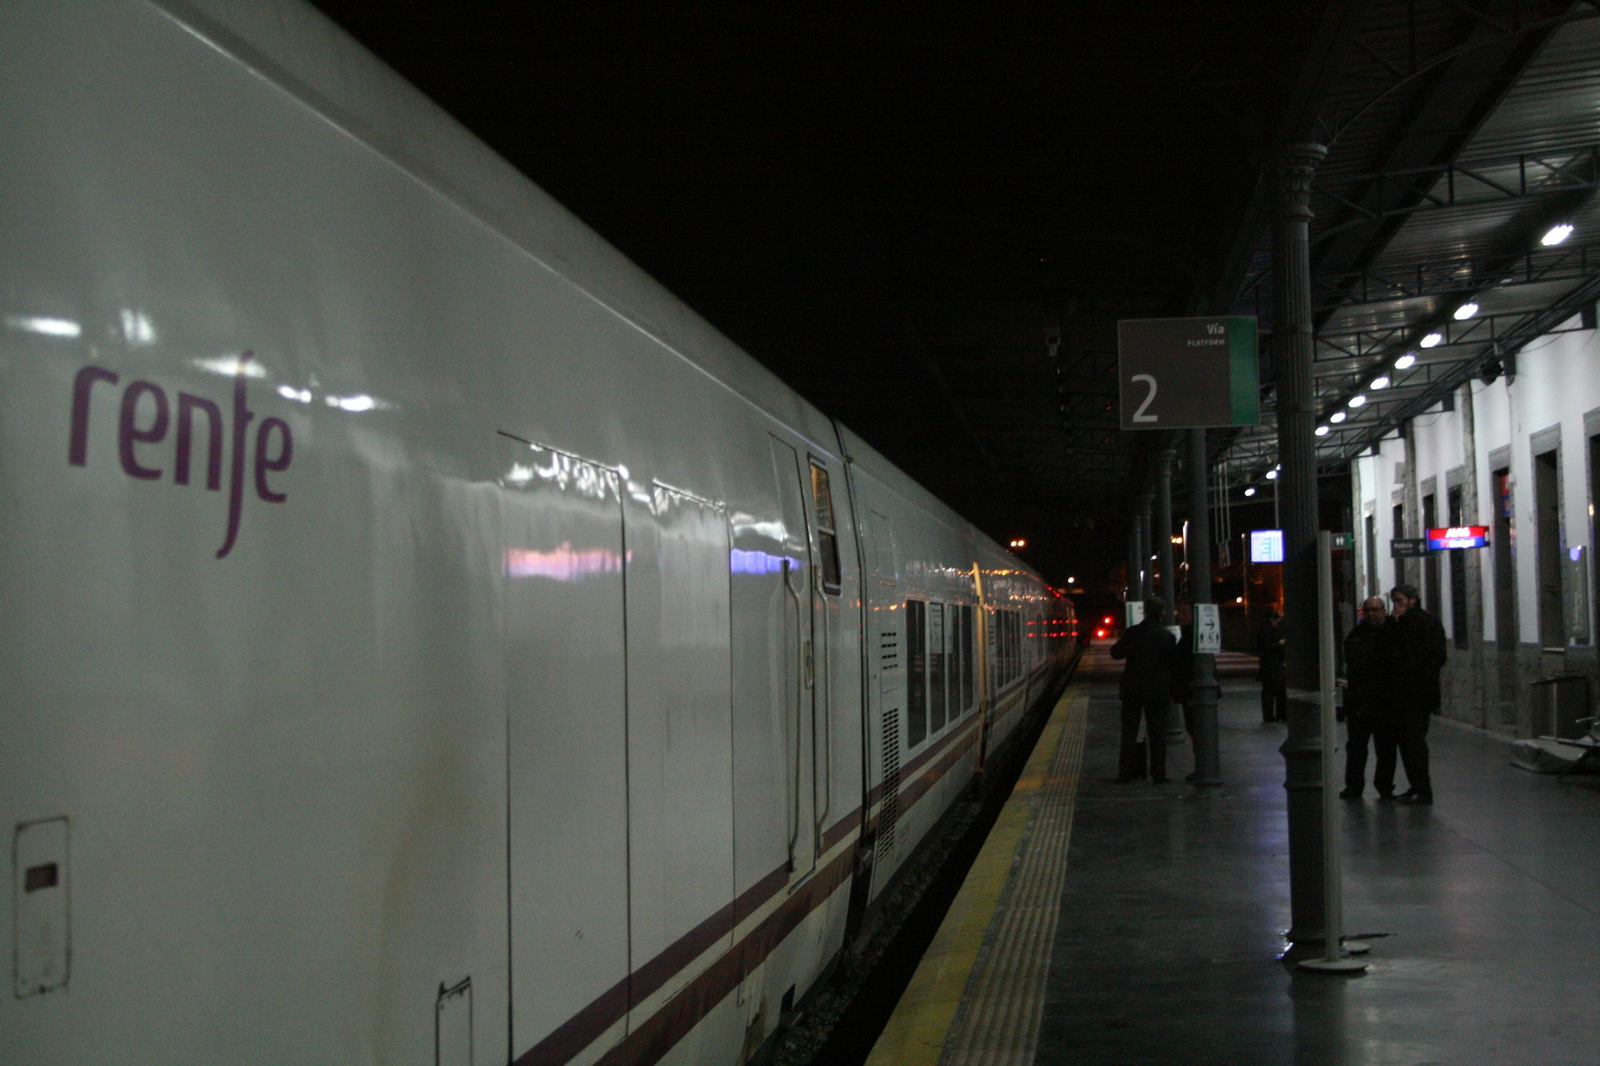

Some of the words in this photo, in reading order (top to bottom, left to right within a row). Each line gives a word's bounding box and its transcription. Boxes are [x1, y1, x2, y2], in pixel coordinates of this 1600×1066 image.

[1187, 339, 1225, 347] PLATFORM
[1206, 323, 1225, 335] Vía
[1131, 374, 1158, 423] 2
[69, 350, 293, 560] renfe
